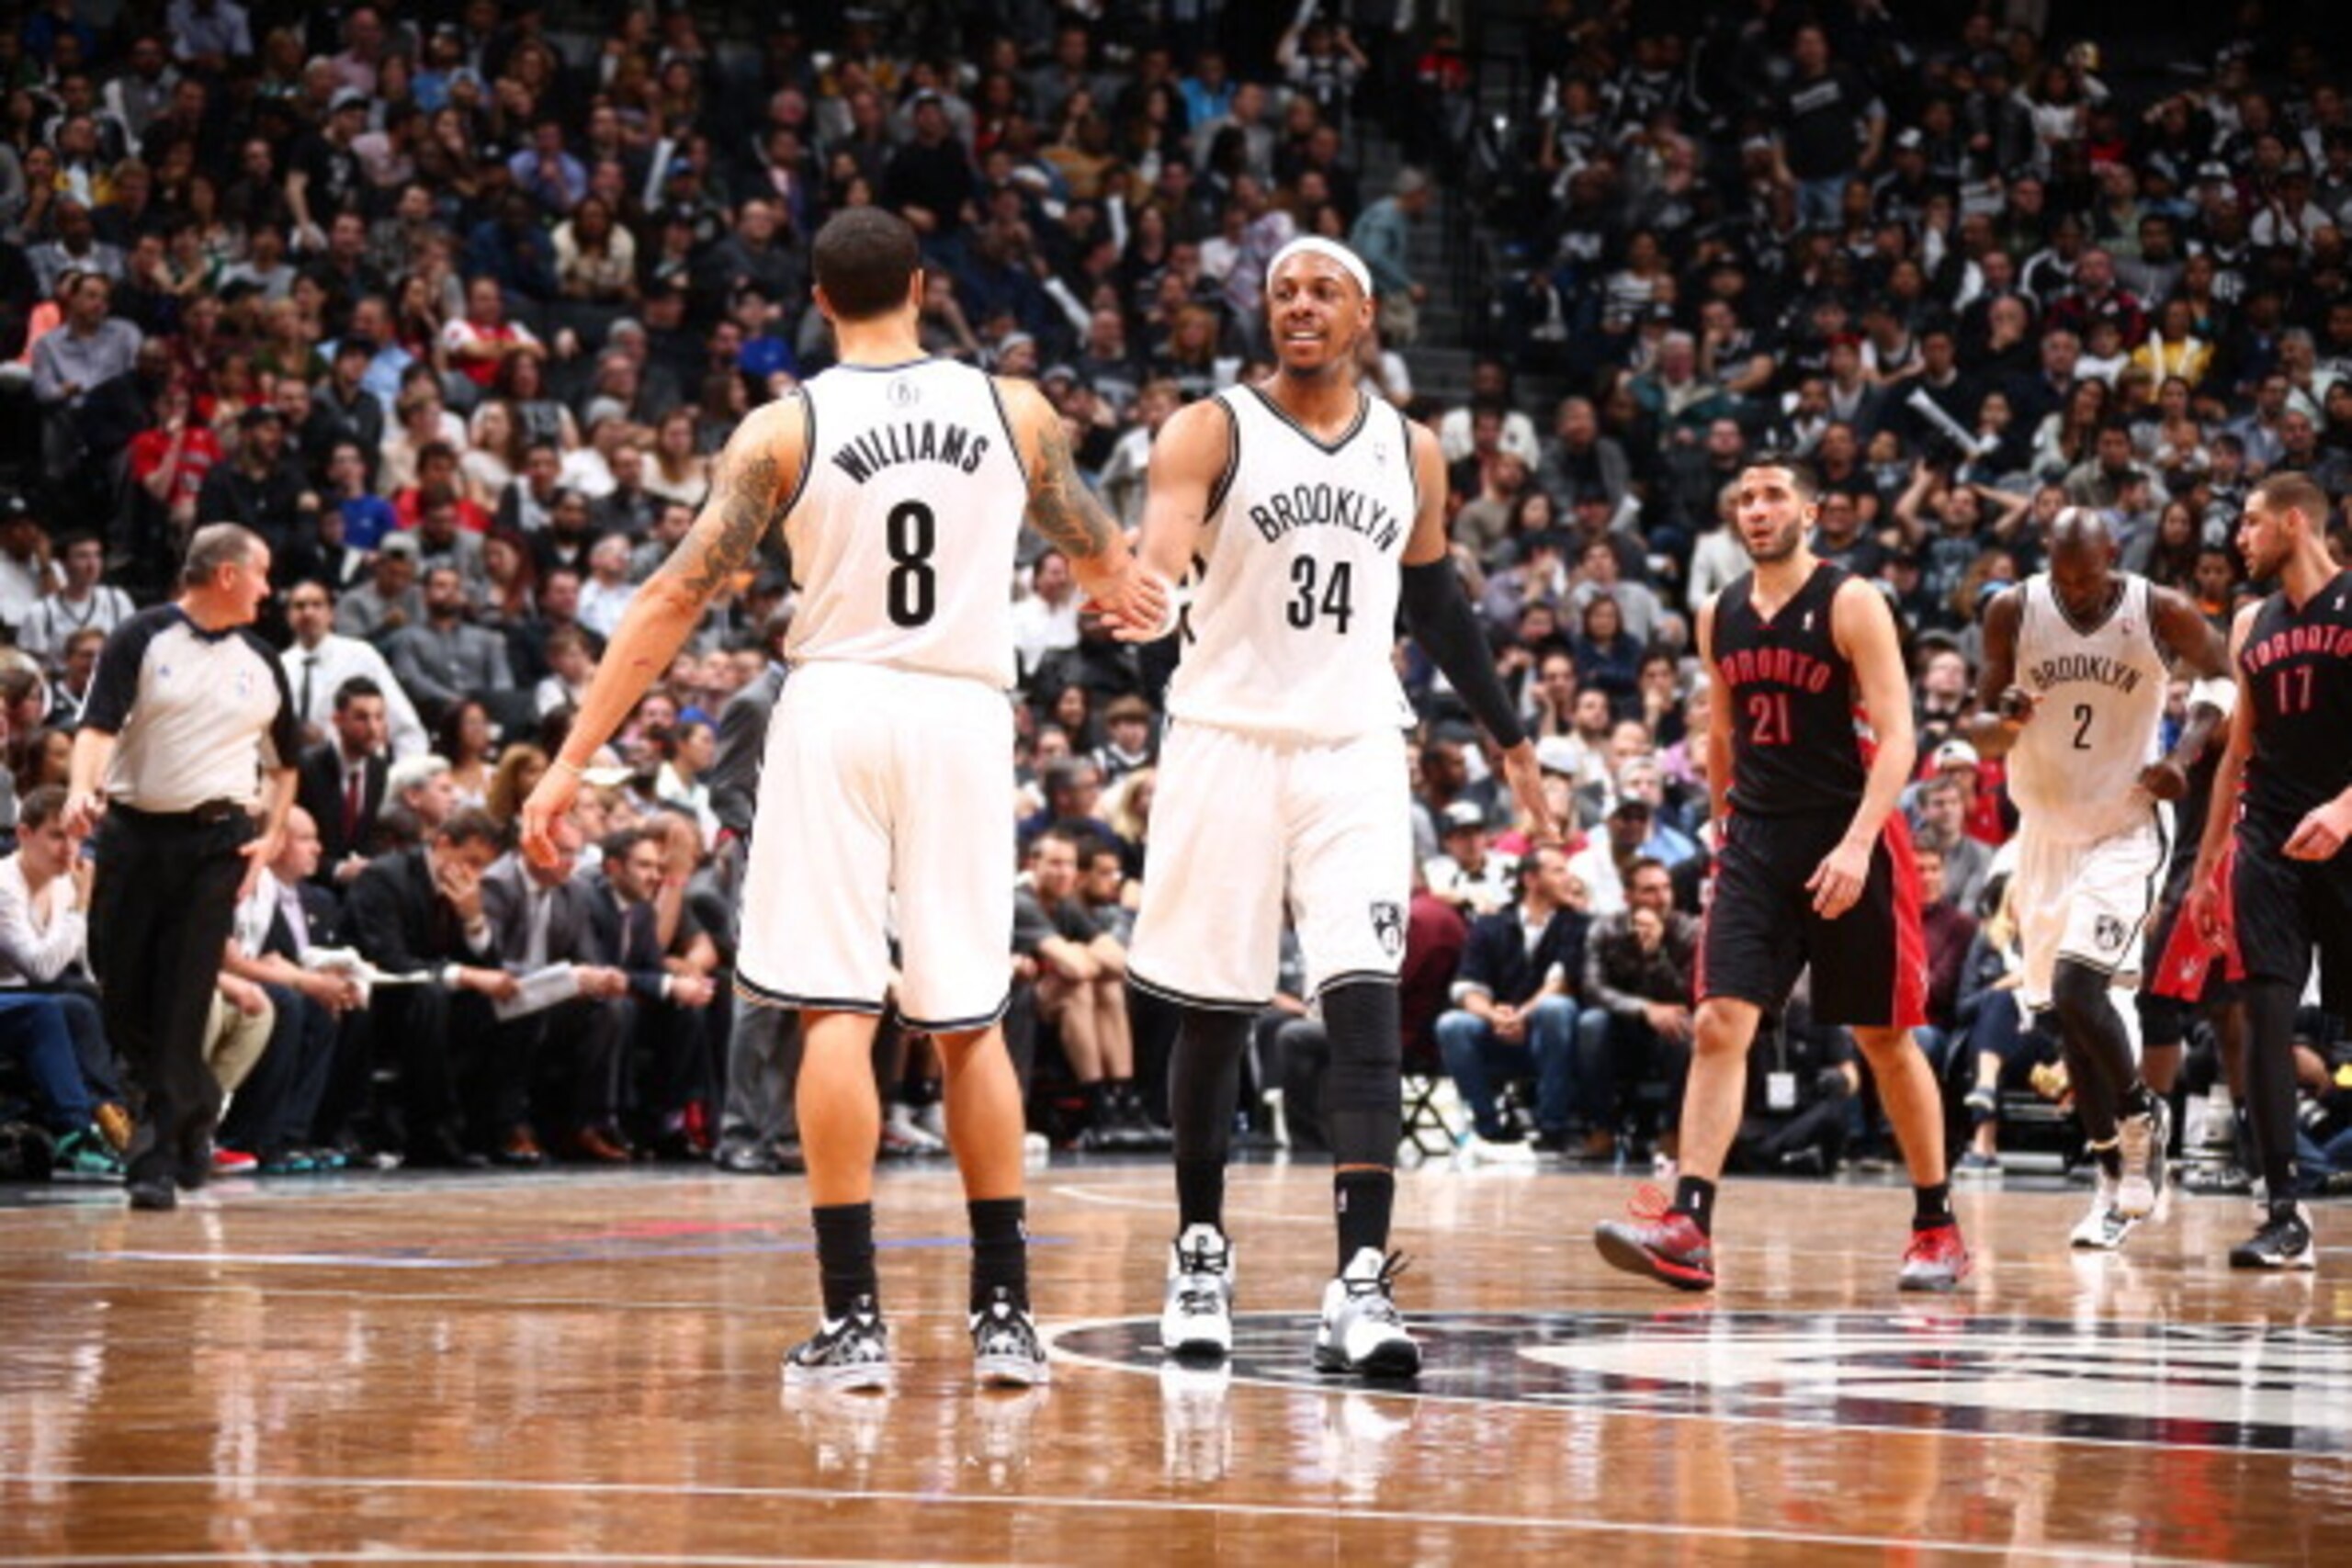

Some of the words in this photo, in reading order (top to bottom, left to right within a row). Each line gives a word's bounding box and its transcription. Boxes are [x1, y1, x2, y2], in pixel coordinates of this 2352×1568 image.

[831, 420, 989, 485] WILLIAMS
[1249, 482, 1402, 553] BROOKLYN
[887, 499, 935, 628] 8
[1286, 553, 1353, 635] 34
[1716, 647, 1832, 694] ORONTO
[2030, 654, 2143, 694] BROOKLYN
[2278, 664, 2313, 715] 17
[1748, 693, 1792, 746] 21
[2073, 703, 2093, 750] 2
